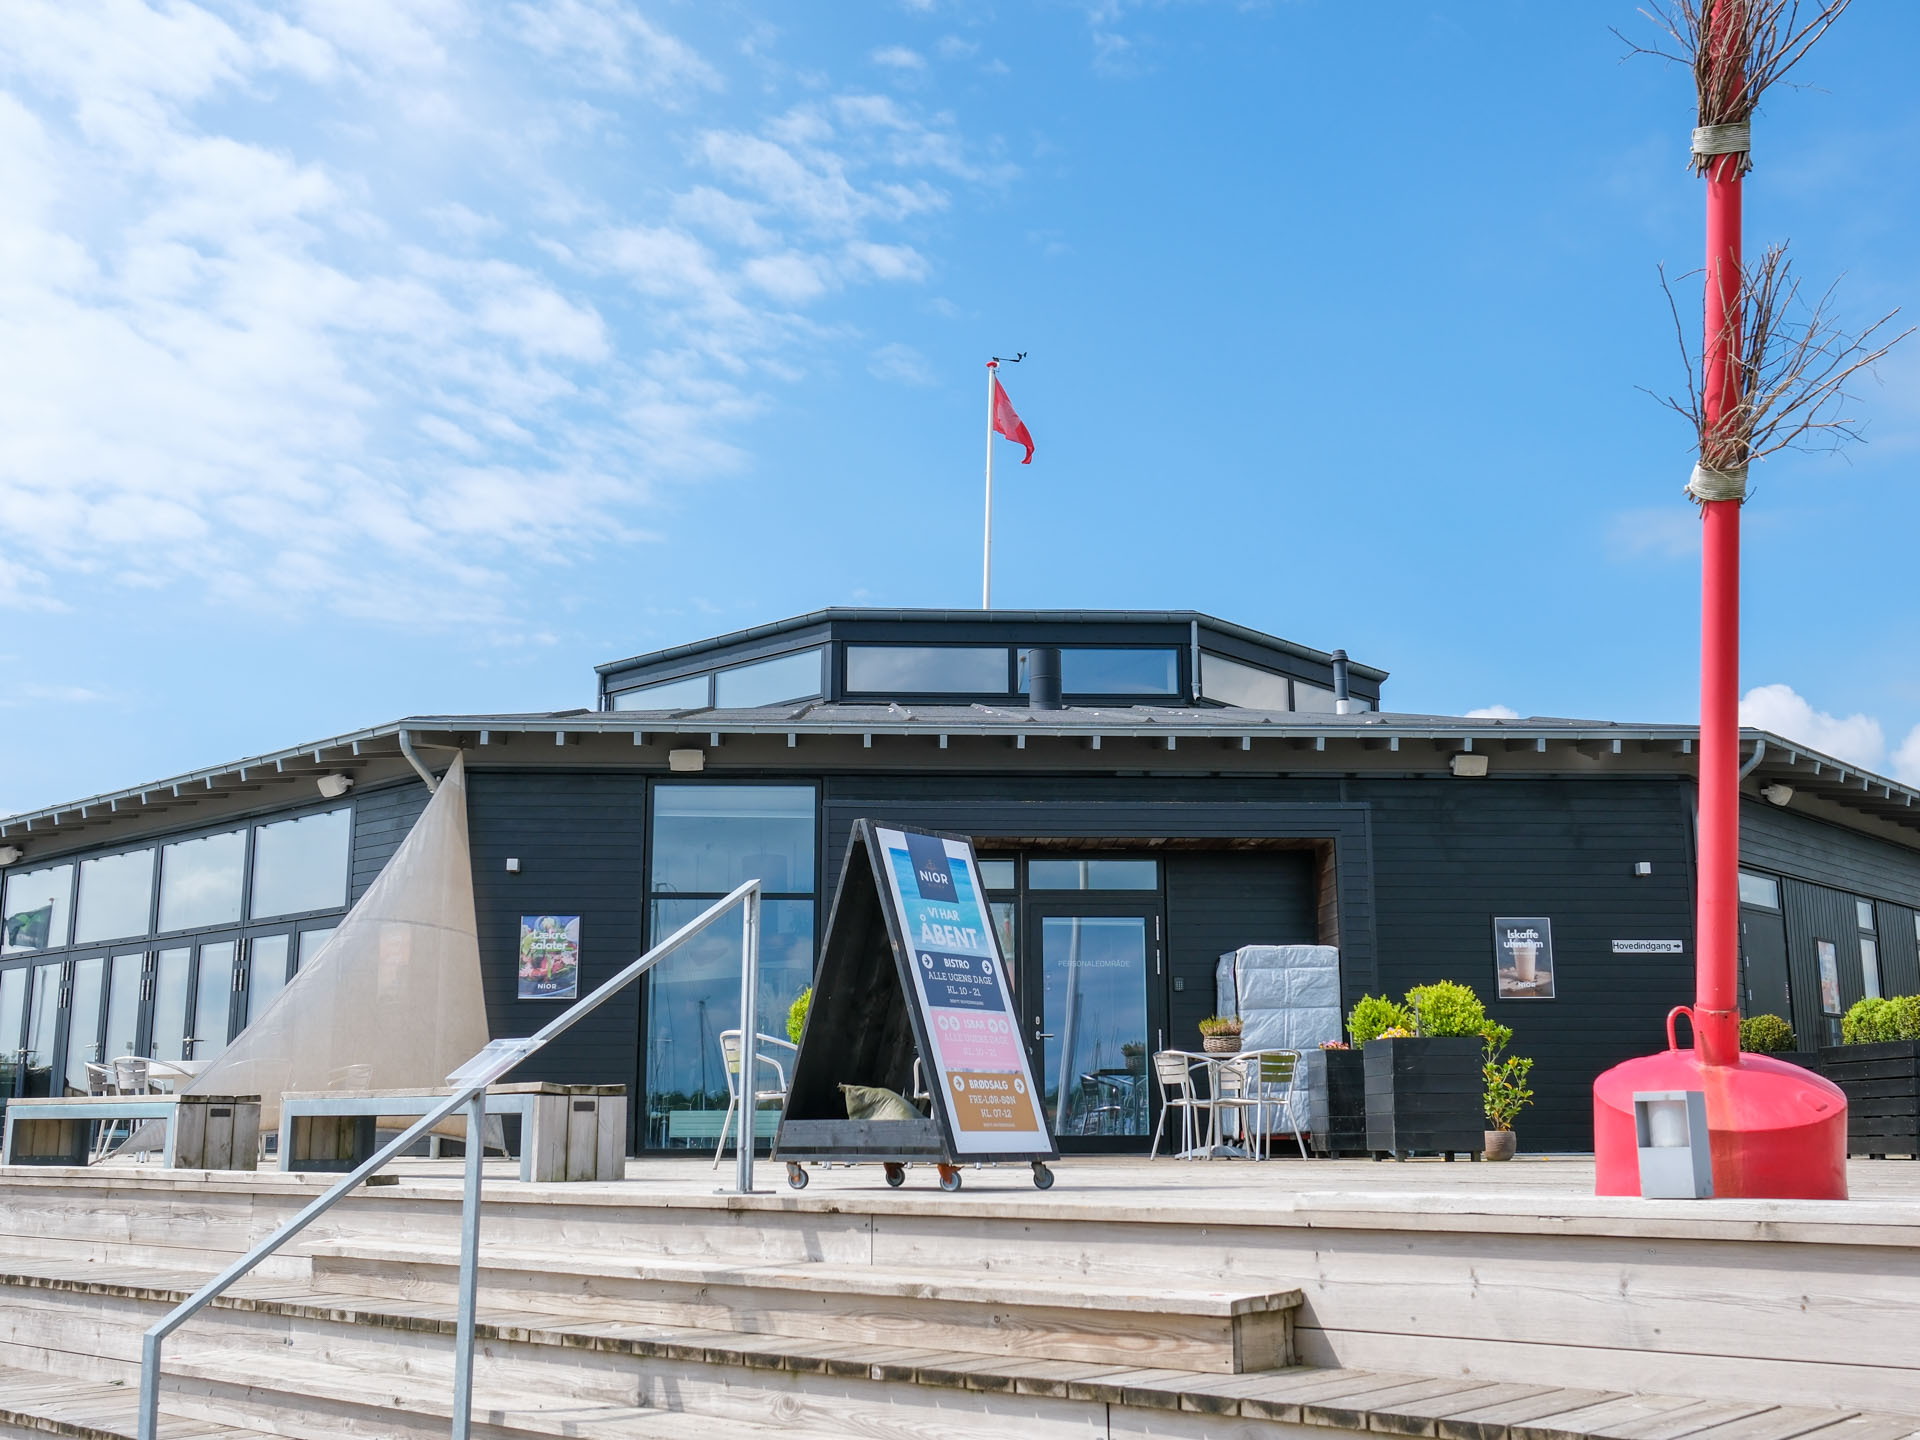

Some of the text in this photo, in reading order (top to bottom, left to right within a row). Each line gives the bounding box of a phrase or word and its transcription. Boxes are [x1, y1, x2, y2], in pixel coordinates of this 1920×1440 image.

[920, 870, 948, 885] NIOR
[928, 907, 960, 921] VI HAR
[533, 929, 568, 939] Lækre
[920, 914, 977, 949] ÅBENT
[1507, 929, 1539, 939] Iskaffe
[530, 939, 569, 950] salater
[1613, 941, 1671, 951] Hovedindgang
[943, 958, 970, 969] BISTRO
[1057, 959, 1131, 968] PERSONALEOMRÅDE
[928, 971, 993, 985] ALLE UGENS DAGE
[959, 986, 968, 996] 10
[972, 987, 982, 996] 21
[968, 1079, 1009, 1090] BRØDSALG
